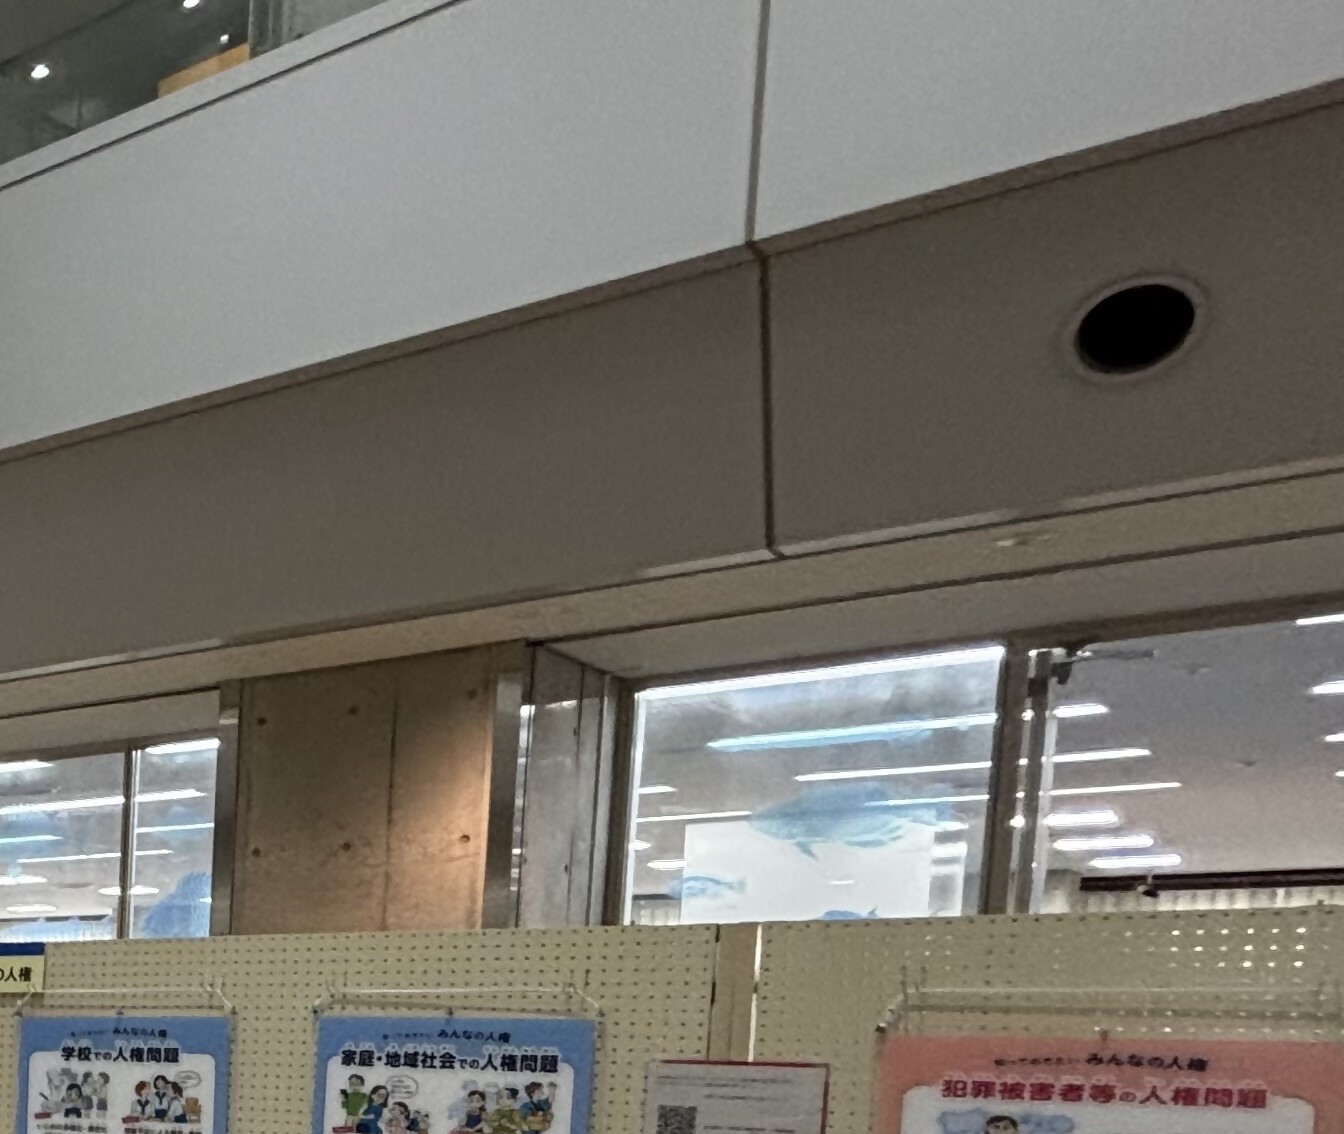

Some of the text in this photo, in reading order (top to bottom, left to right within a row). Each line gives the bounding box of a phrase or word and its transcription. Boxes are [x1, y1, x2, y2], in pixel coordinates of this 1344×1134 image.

[436, 1028, 511, 1044] みんなの人権
[61, 1046, 180, 1063] 学校での人権問題
[340, 1049, 560, 1074] 家庭・地域社会での人権問題
[1085, 1053, 1210, 1073] みんなの人権
[941, 1078, 1268, 1109] 犯罪被害者等の人権問題
